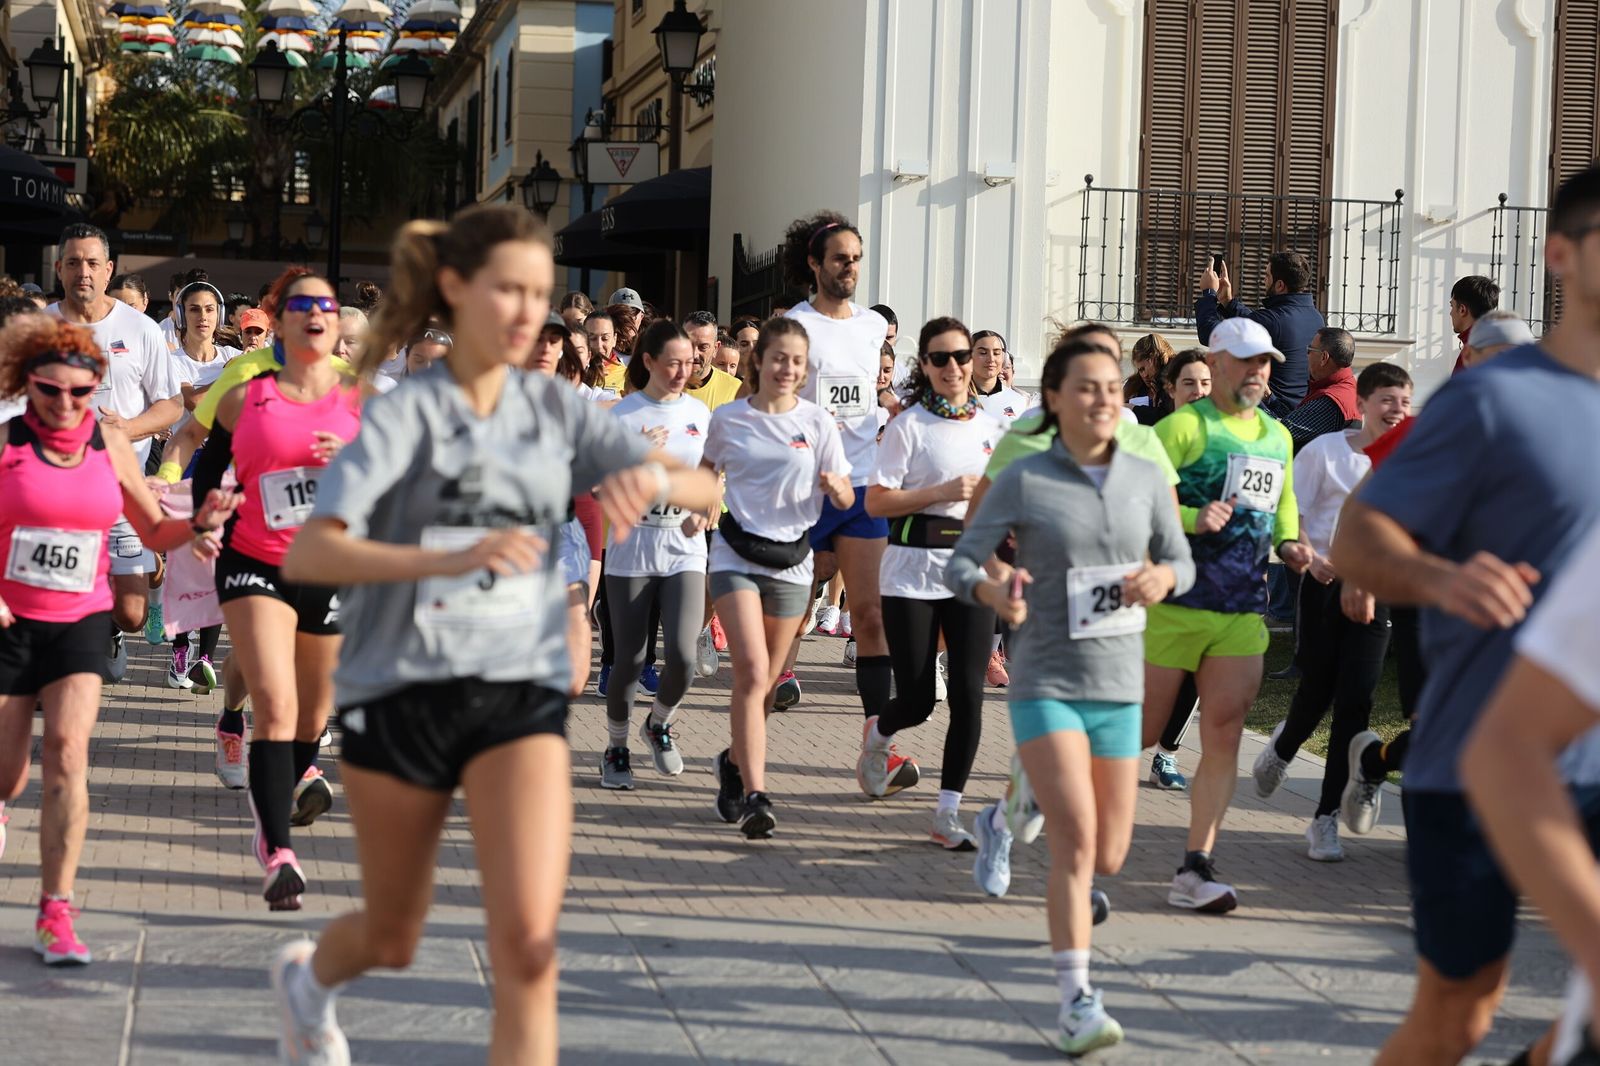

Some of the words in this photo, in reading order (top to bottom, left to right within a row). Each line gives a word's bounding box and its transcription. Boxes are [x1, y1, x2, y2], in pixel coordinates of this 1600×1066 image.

[830, 385, 861, 404] 204
[284, 479, 317, 507] 119
[1242, 469, 1273, 493] 239
[31, 543, 79, 570] 456
